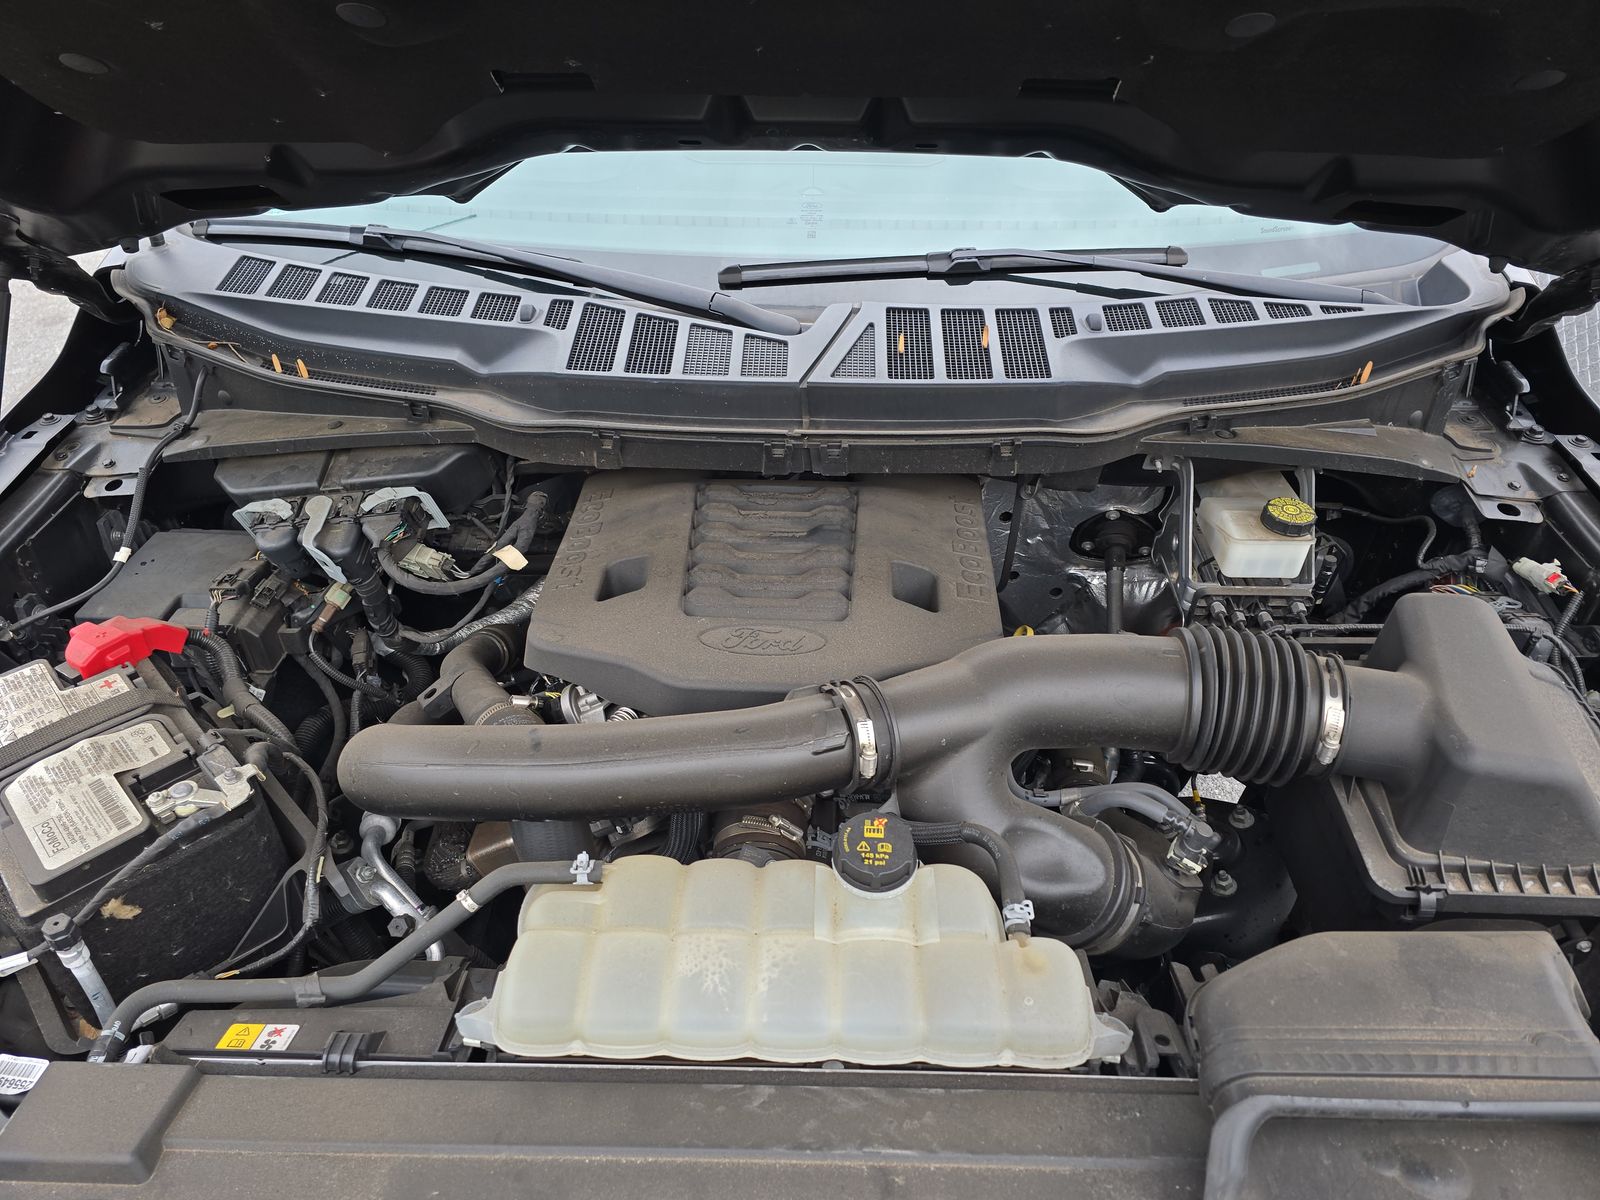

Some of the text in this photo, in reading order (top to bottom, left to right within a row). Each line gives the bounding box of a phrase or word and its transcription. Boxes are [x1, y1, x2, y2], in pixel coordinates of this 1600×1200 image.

[720, 627, 806, 652] Ford
[41, 821, 64, 854] FoMoCo
[875, 852, 890, 860] kPa
